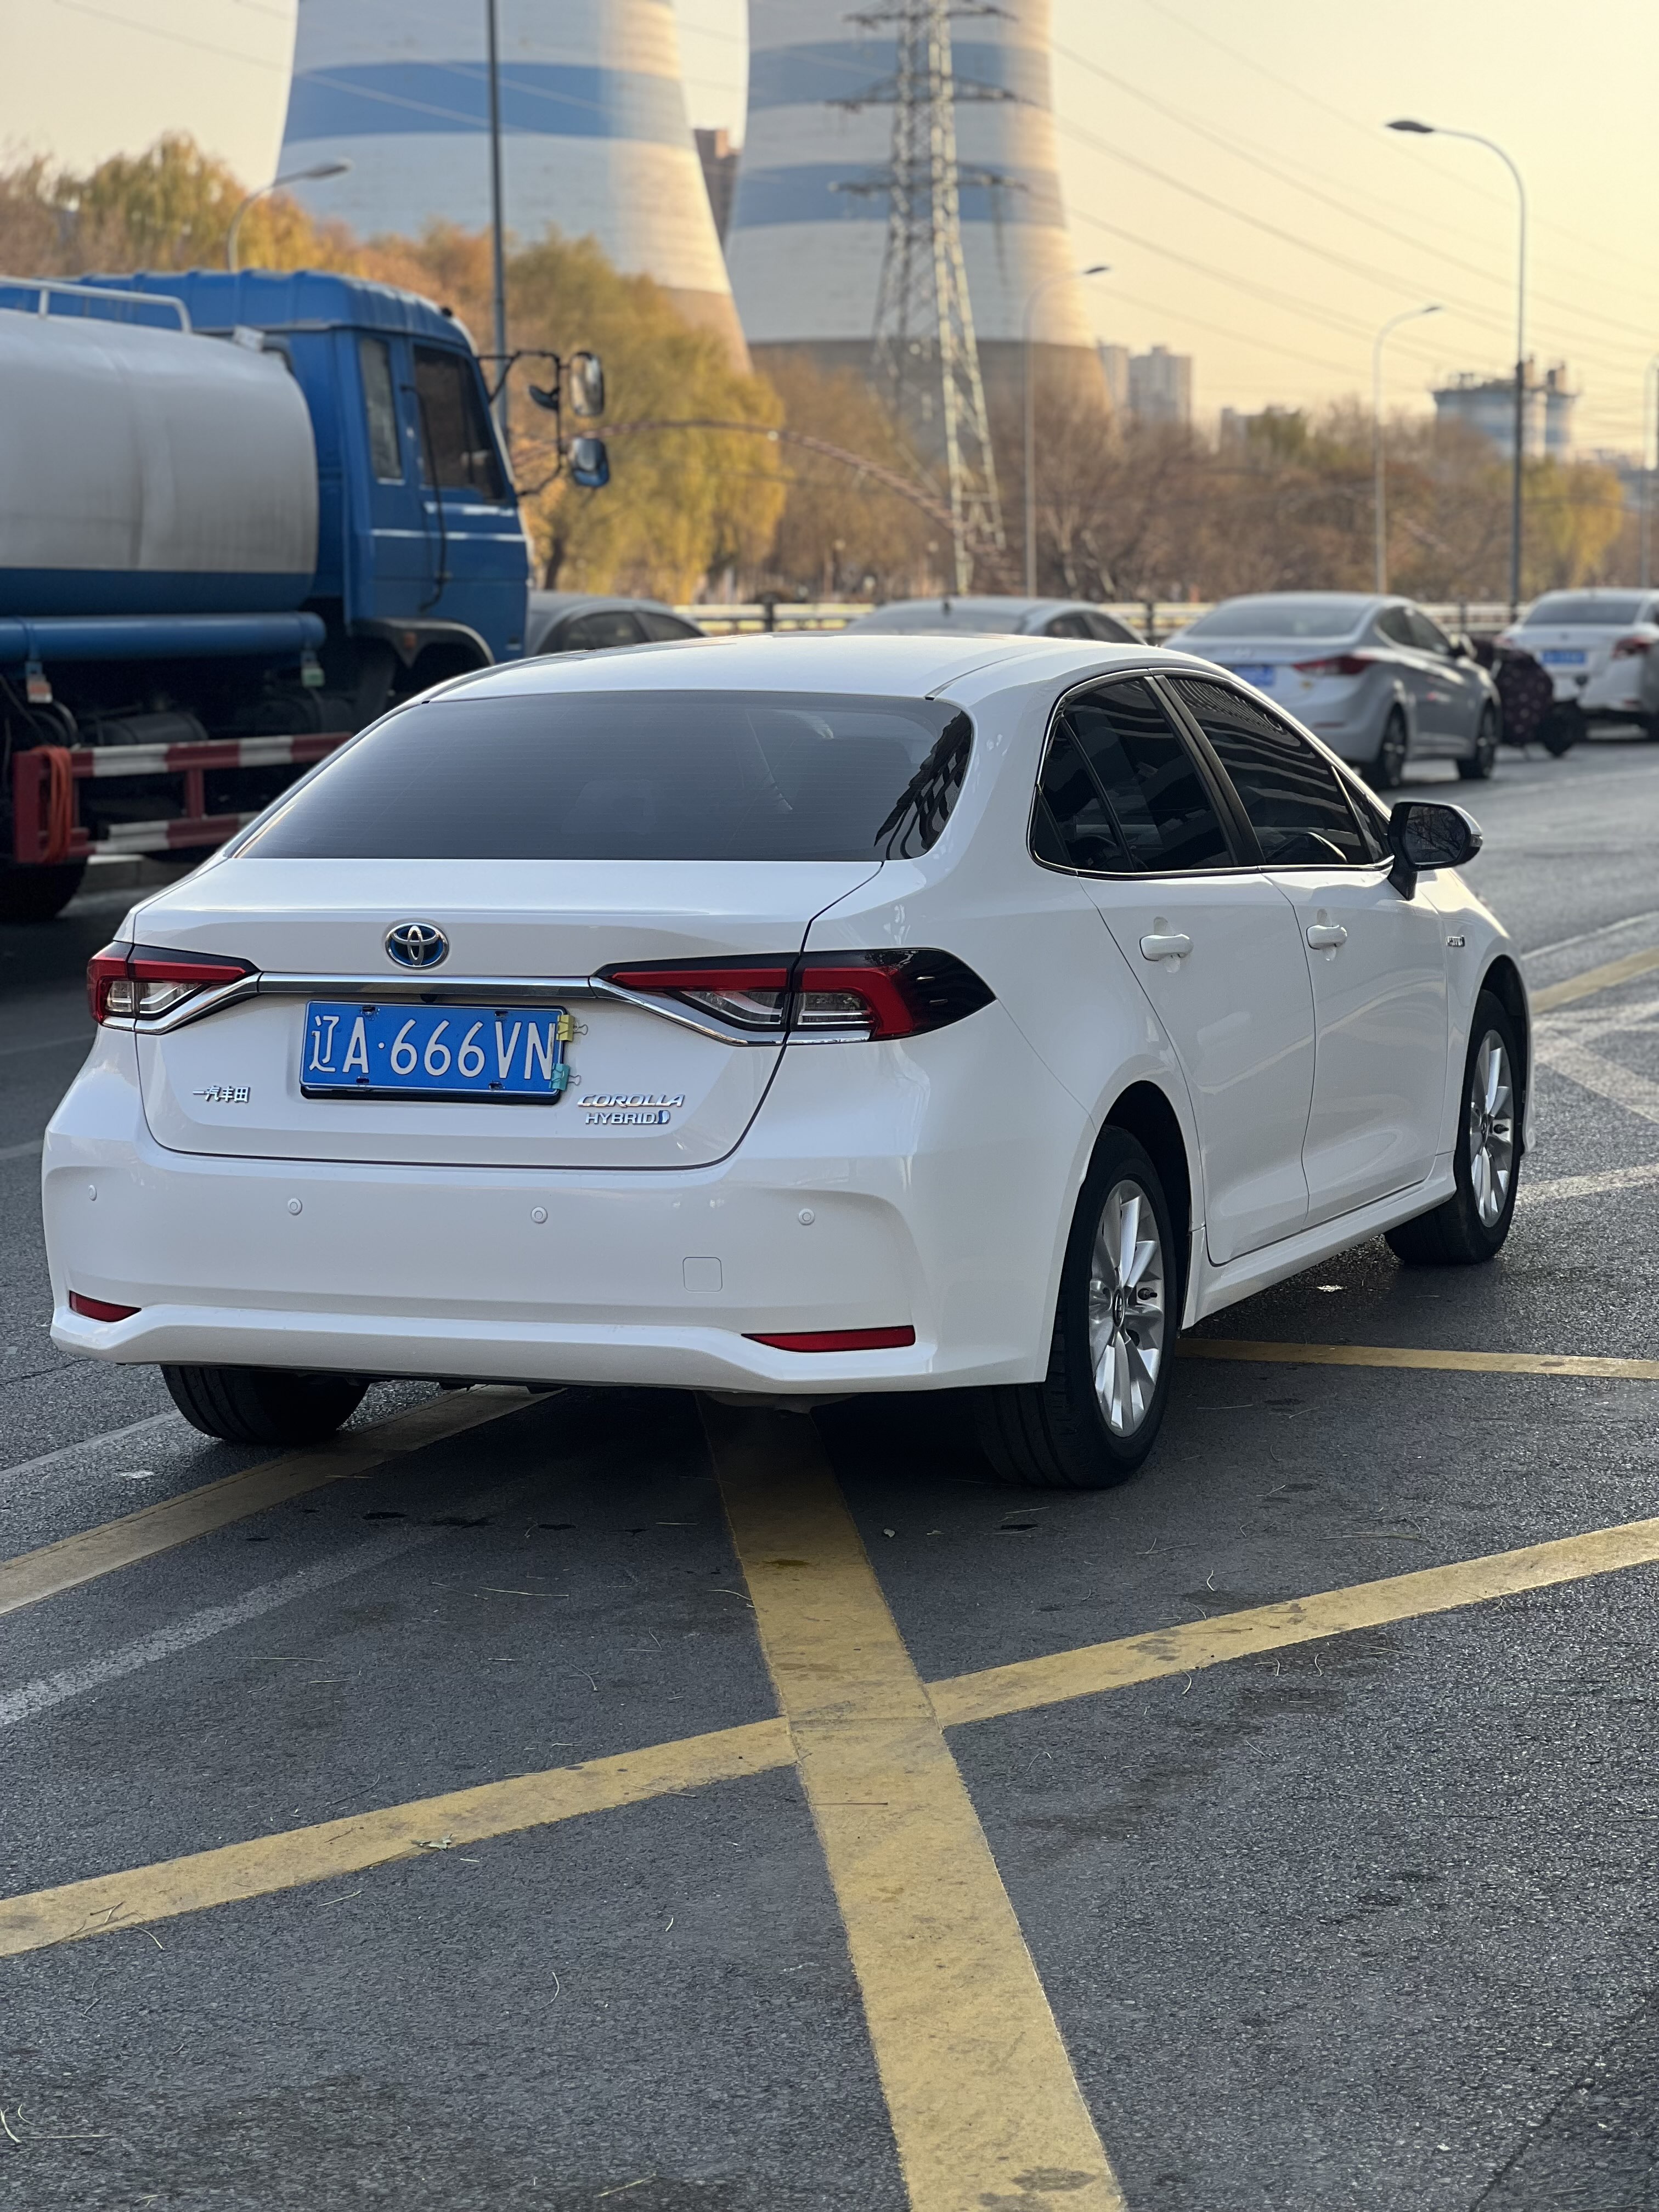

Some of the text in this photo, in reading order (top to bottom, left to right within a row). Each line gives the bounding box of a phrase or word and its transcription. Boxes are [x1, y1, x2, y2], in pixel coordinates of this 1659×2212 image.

[193, 1086, 250, 1103] 一汽丰田
[577, 1093, 685, 1108] COROLLA
[585, 1112, 656, 1125] HYBRID
